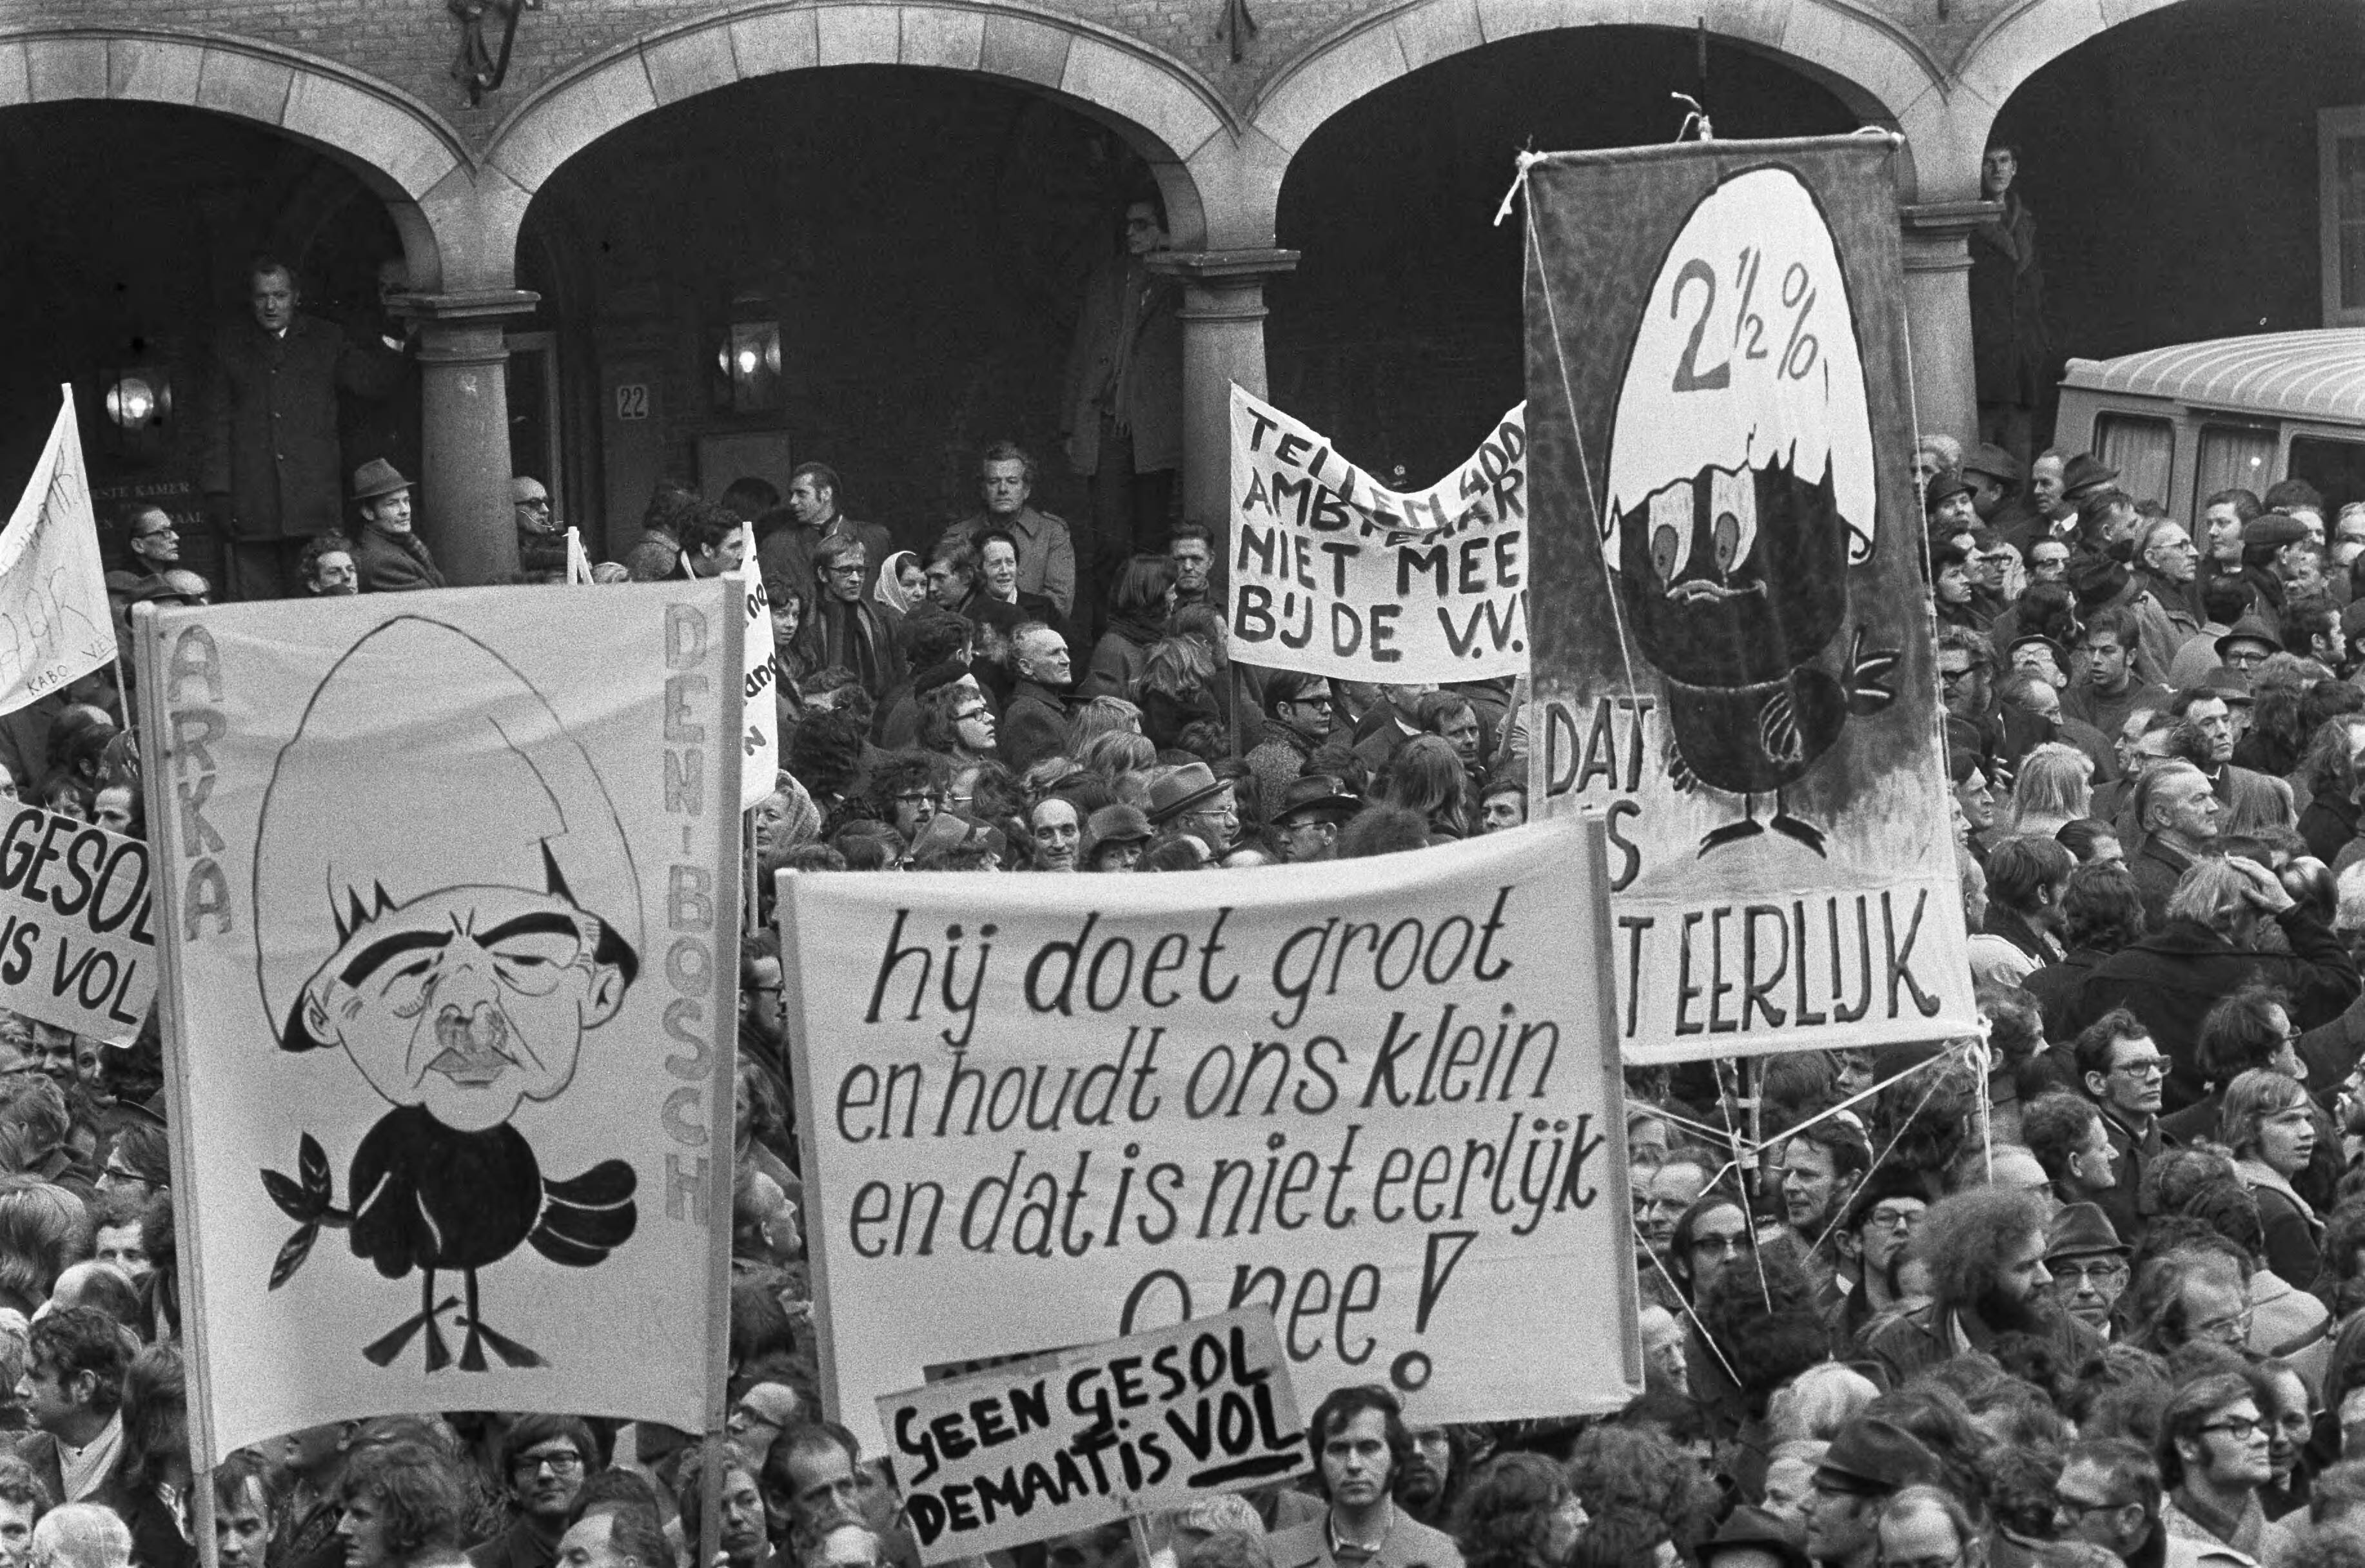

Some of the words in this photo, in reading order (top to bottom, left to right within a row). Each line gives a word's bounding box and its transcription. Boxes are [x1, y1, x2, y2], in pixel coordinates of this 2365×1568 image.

[620, 387, 645, 417] 22
[1237, 524, 1360, 598] NIET
[1331, 602, 1404, 663] DE
[1437, 589, 1530, 658] V.V.
[168, 624, 232, 941] ARKA
[1546, 696, 1656, 796] DAT
[0, 808, 155, 946] GESOL
[52, 936, 137, 1024] VOL
[864, 908, 998, 1048] hij
[1024, 906, 1239, 1017] doet
[1271, 885, 1513, 1030] groot
[1675, 887, 1941, 1037] EERLIJK
[1185, 1035, 1349, 1119] ons
[1358, 1002, 1559, 1108] klein
[849, 1180, 945, 1259] en
[959, 1149, 1095, 1259] dat
[1104, 1142, 1184, 1247] is
[1195, 1124, 1362, 1239] niet
[1373, 1112, 1606, 1237] eerlijk
[895, 1380, 1051, 1485] GEEN
[1066, 1326, 1270, 1436] GESOL
[1165, 1383, 1305, 1462] VOL
